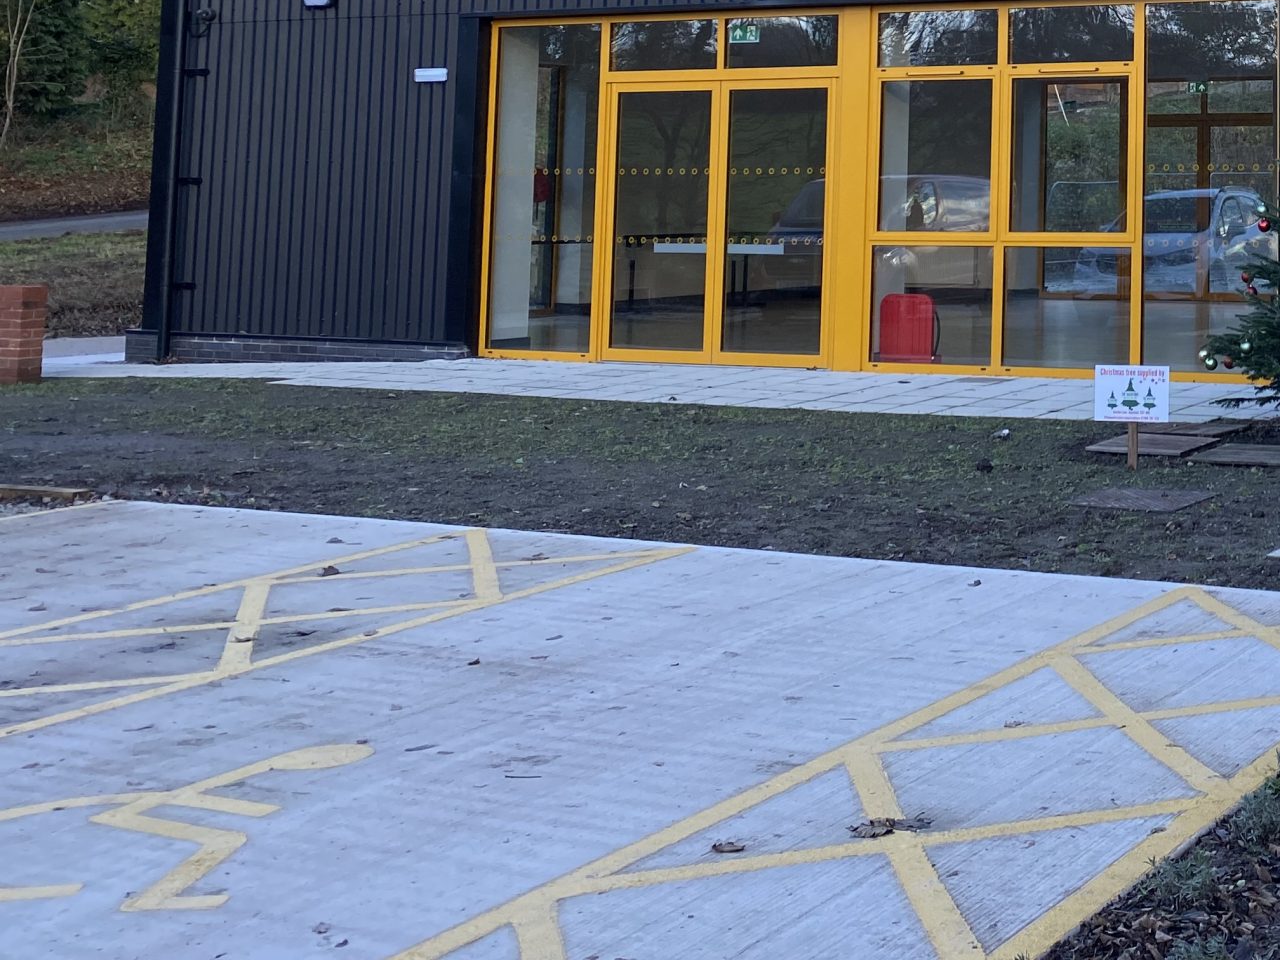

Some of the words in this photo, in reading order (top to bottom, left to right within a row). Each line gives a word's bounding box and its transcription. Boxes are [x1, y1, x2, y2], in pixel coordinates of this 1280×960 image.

[1100, 368, 1125, 376] Christmas
[1137, 369, 1158, 378] supplied
[1159, 369, 1165, 378] by
